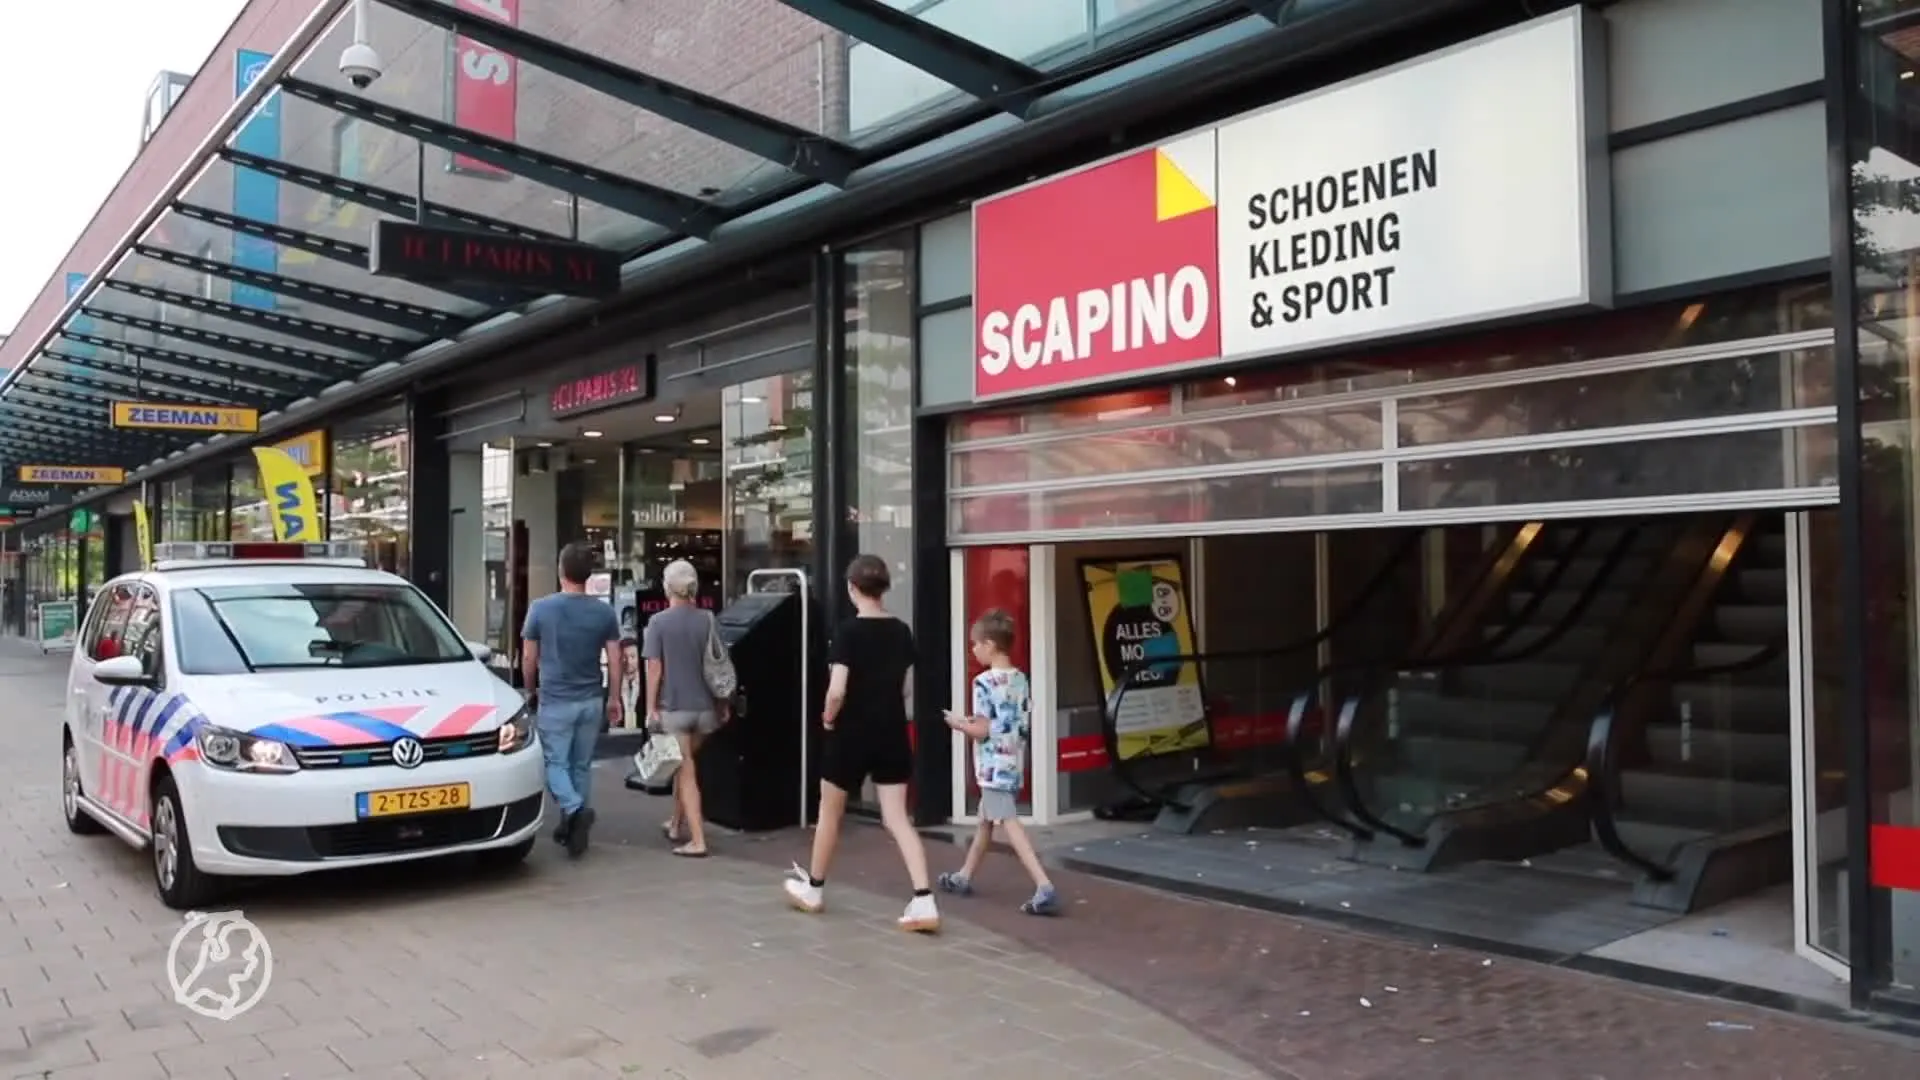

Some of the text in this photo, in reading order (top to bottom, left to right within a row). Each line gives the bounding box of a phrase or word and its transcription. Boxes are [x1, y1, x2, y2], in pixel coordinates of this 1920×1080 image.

[1248, 148, 1437, 230] SCHOENEN
[465, 240, 551, 276] PARIS
[1249, 211, 1401, 280] KLEDING
[1250, 266, 1396, 329] & SPORT
[980, 264, 1209, 376] SCAPINO
[575, 372, 617, 406] PARIS
[128, 407, 244, 427] ZEEMAN XL
[31, 468, 95, 482] ZEEMAN
[1115, 622, 1161, 641] ALLES
[315, 688, 441, 704] POLITIE
[377, 787, 461, 813] 2-TZS-28
